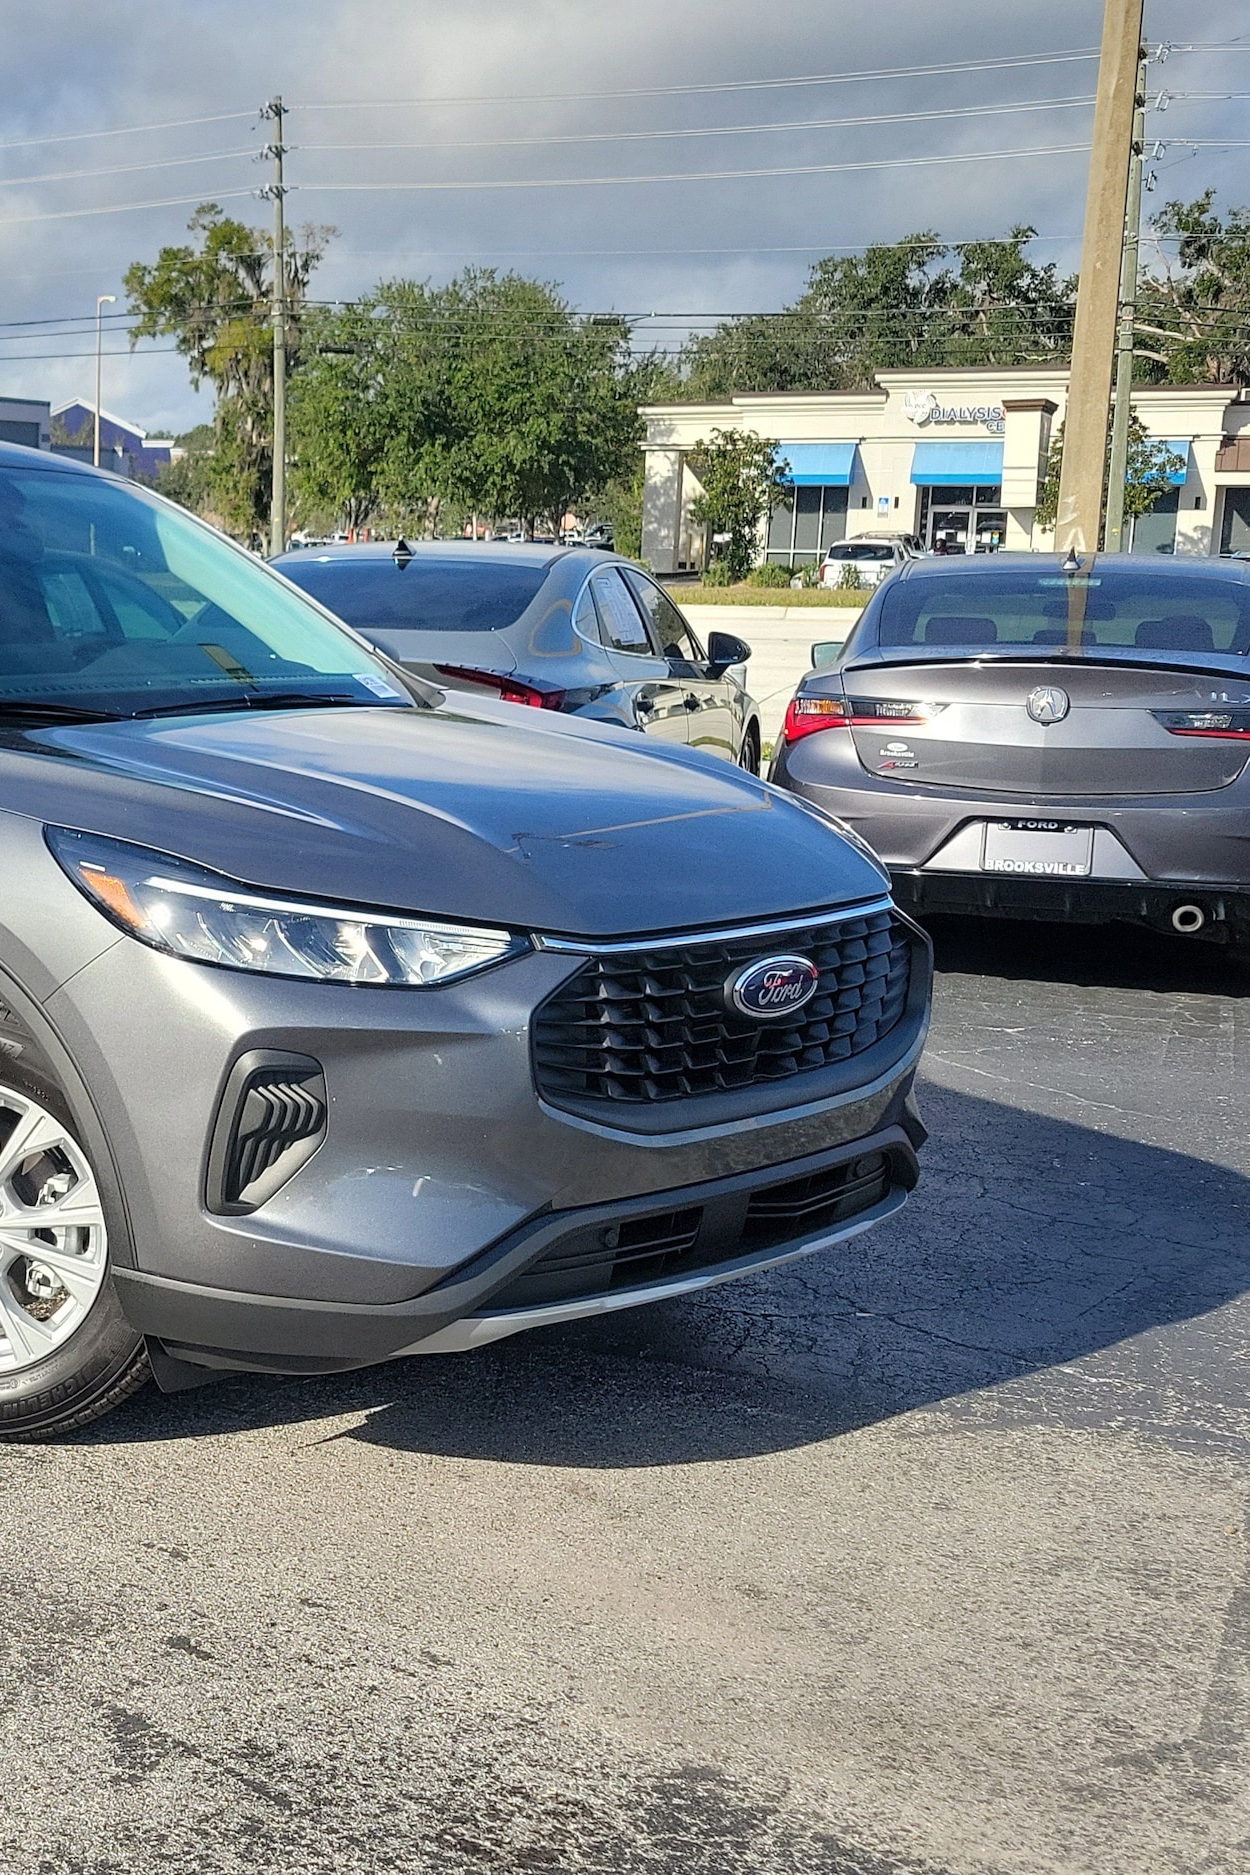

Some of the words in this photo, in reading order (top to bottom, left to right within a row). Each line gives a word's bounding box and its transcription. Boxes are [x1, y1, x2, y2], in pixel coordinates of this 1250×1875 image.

[931, 406, 1002, 420] DIALYSIS
[1017, 820, 1059, 830] FORD
[984, 859, 1086, 875] BROOKSVILLE
[758, 968, 804, 1006] Ford
